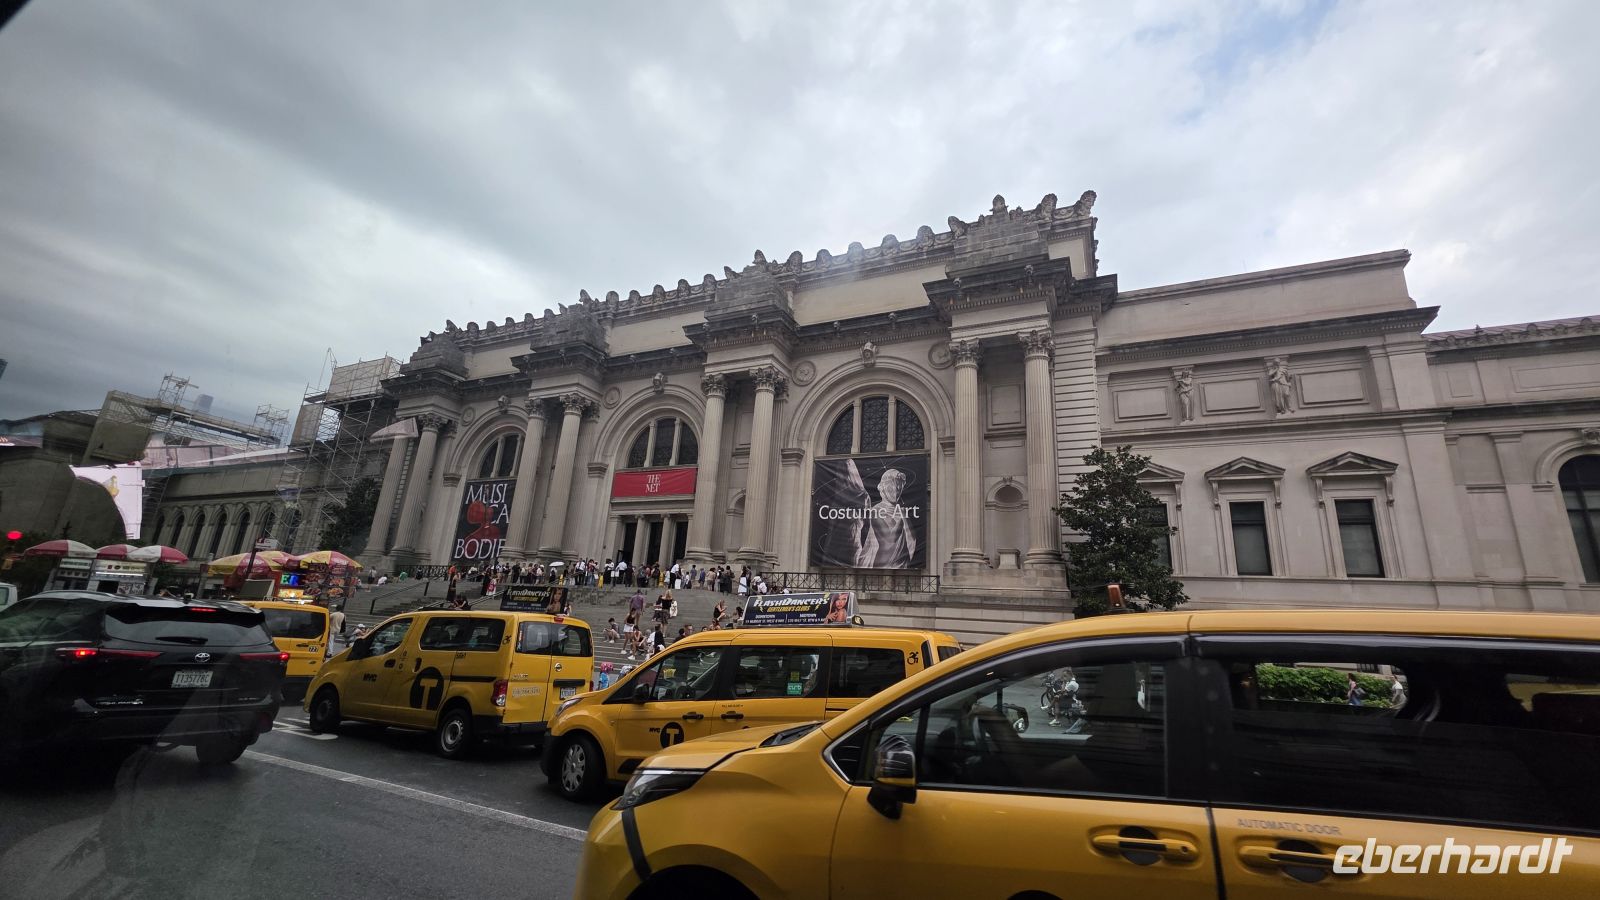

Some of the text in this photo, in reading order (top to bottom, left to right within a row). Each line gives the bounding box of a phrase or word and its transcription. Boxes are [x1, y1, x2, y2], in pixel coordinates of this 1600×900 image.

[647, 474, 660, 483] THE
[819, 504, 920, 519] Costume Art
[1238, 819, 1342, 836] AUTOMATIC DOOR
